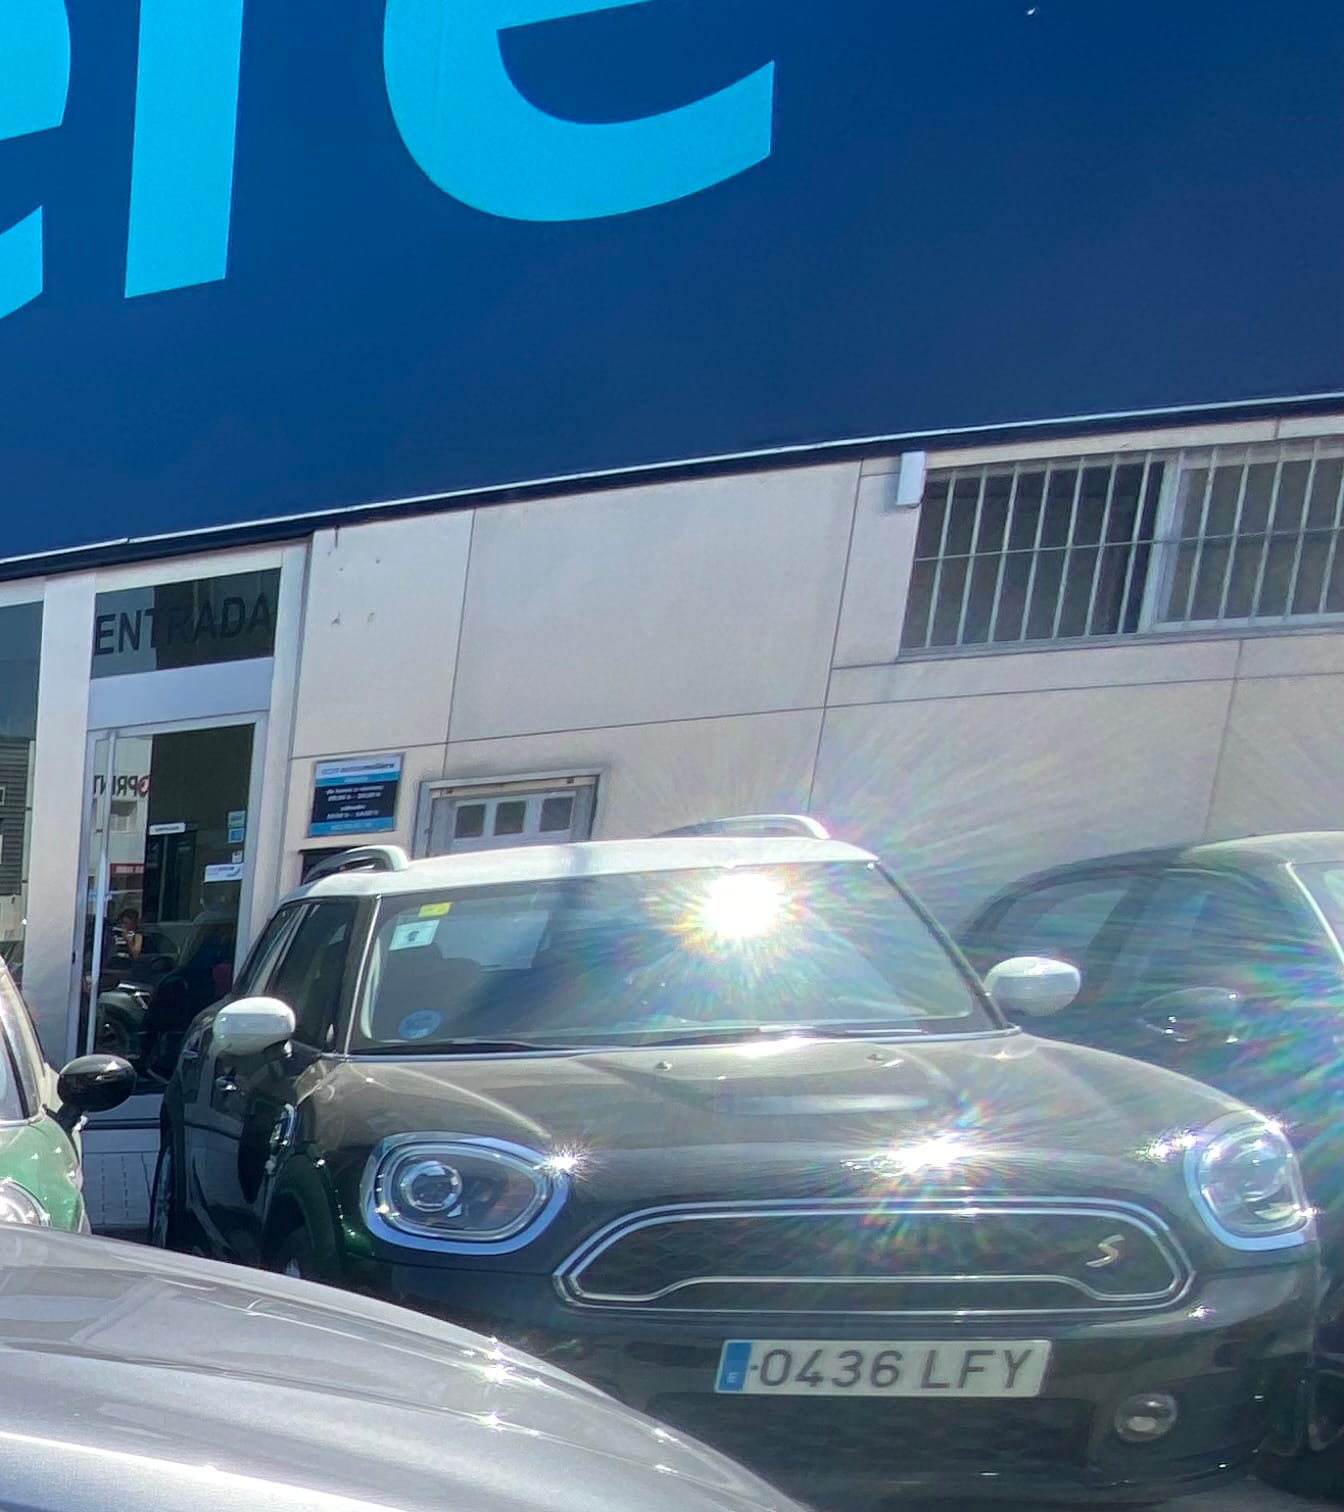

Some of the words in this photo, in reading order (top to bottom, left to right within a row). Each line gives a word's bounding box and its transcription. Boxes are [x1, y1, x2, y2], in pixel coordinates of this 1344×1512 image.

[94, 592, 274, 656] ENTRADA
[759, 1348, 903, 1388] 0436
[921, 1348, 1032, 1390] LFY
